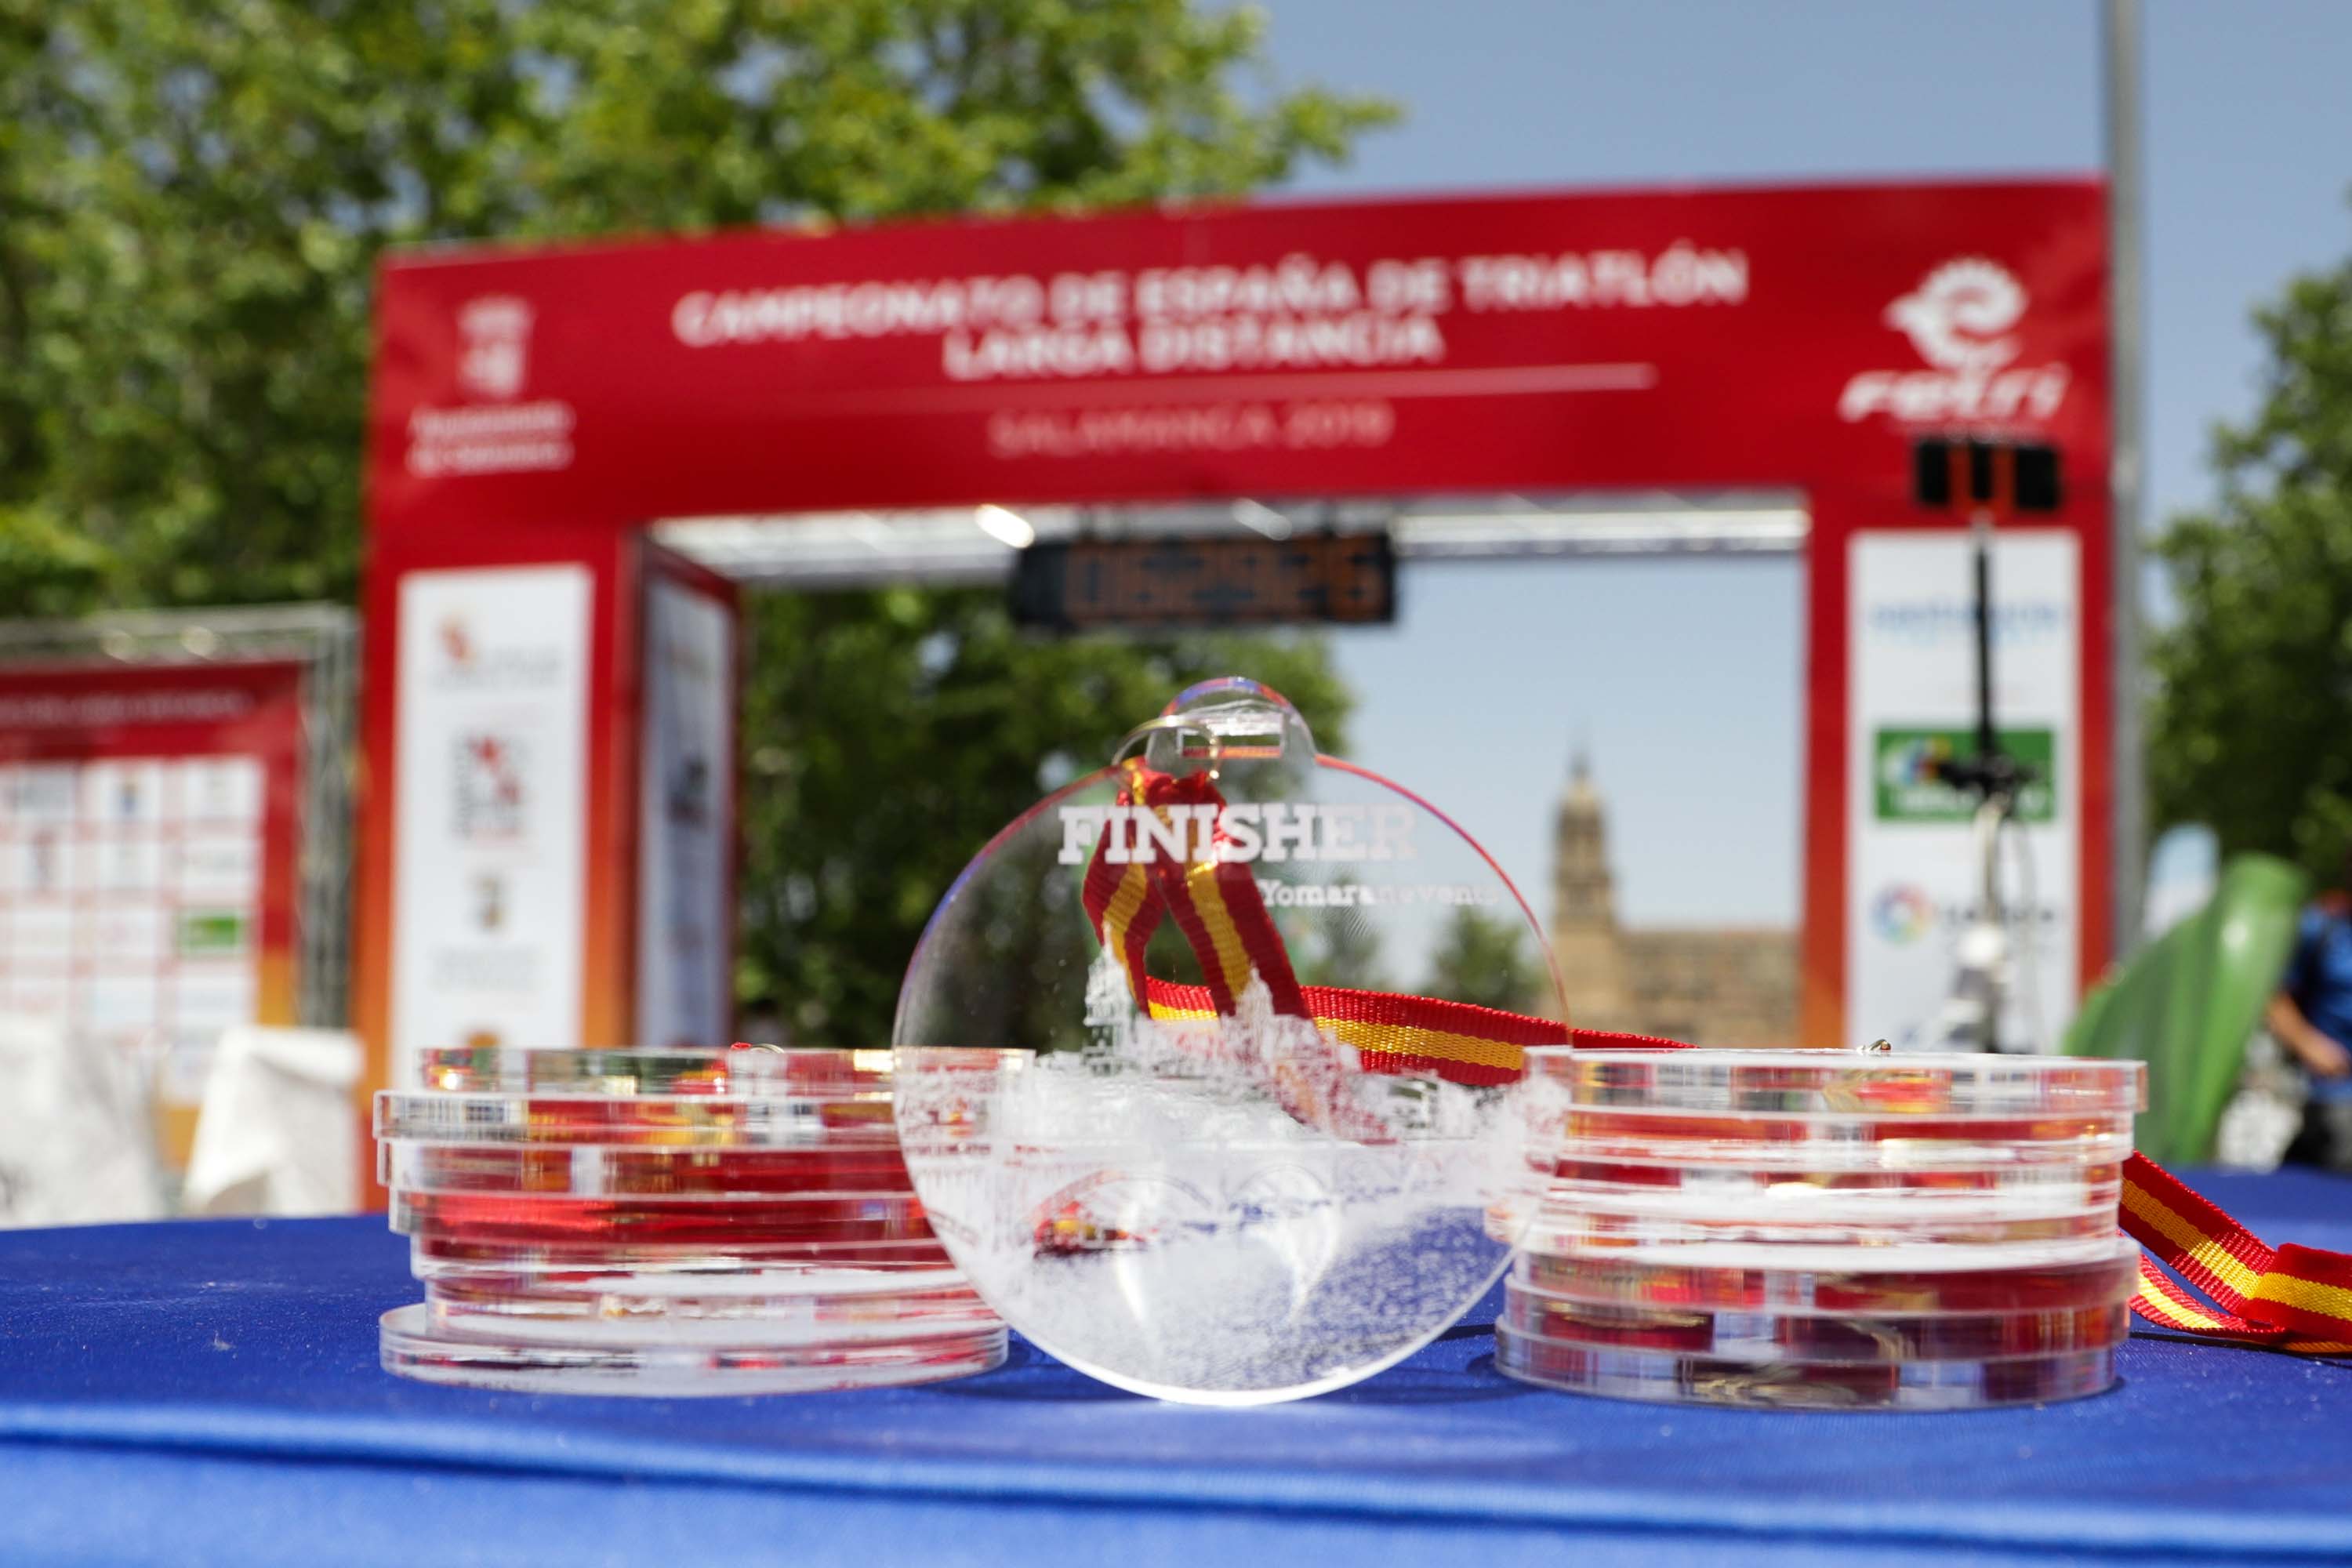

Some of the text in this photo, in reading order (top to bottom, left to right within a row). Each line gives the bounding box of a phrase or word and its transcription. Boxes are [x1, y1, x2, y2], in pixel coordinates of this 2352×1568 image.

[673, 239, 1749, 347] CAMPEONATO DE ESPAÑA DE TRIATLÓN
[942, 314, 1446, 380] LARGA DISTANCIA
[988, 405, 1278, 457] SALAMANCA
[1058, 803, 1417, 865] FINISHER
